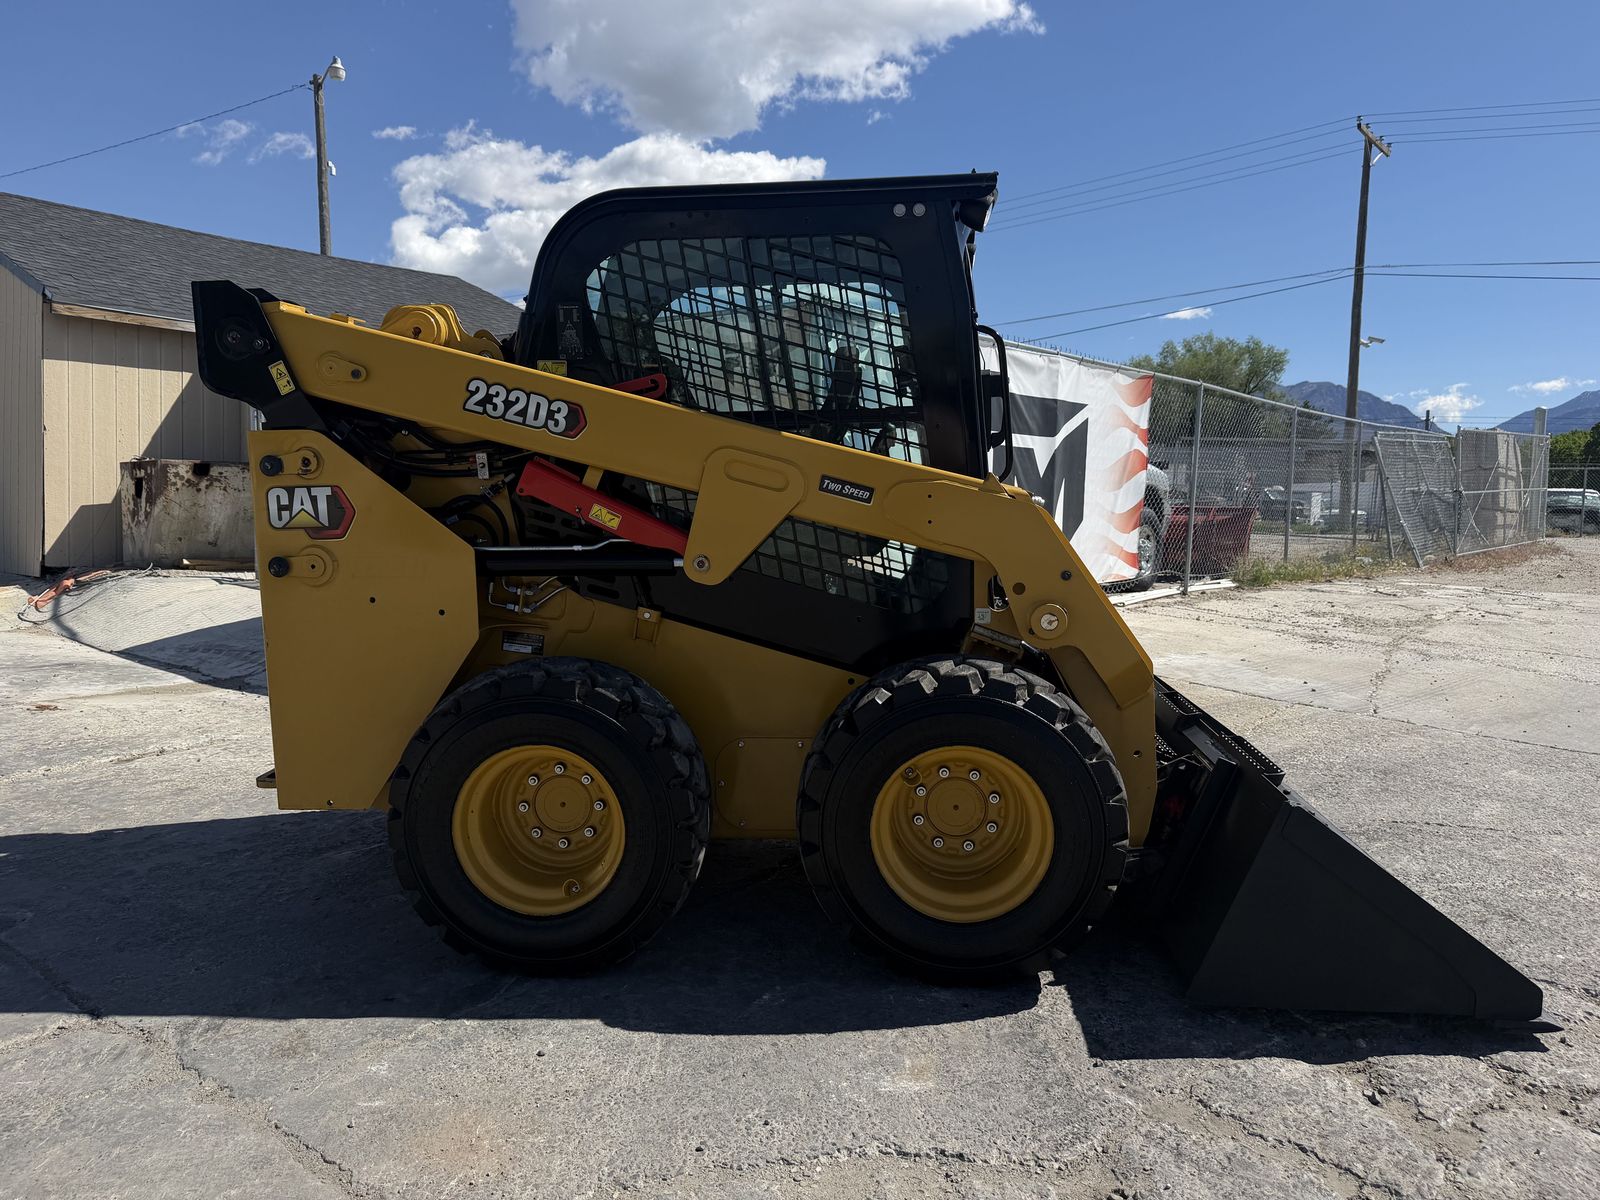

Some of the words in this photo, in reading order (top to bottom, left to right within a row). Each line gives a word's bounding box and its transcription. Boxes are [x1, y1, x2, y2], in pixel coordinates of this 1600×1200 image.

[464, 379, 569, 434] 232D3
[267, 486, 332, 529] CAT
[823, 480, 842, 492] TWO
[843, 485, 870, 499] SPEED
